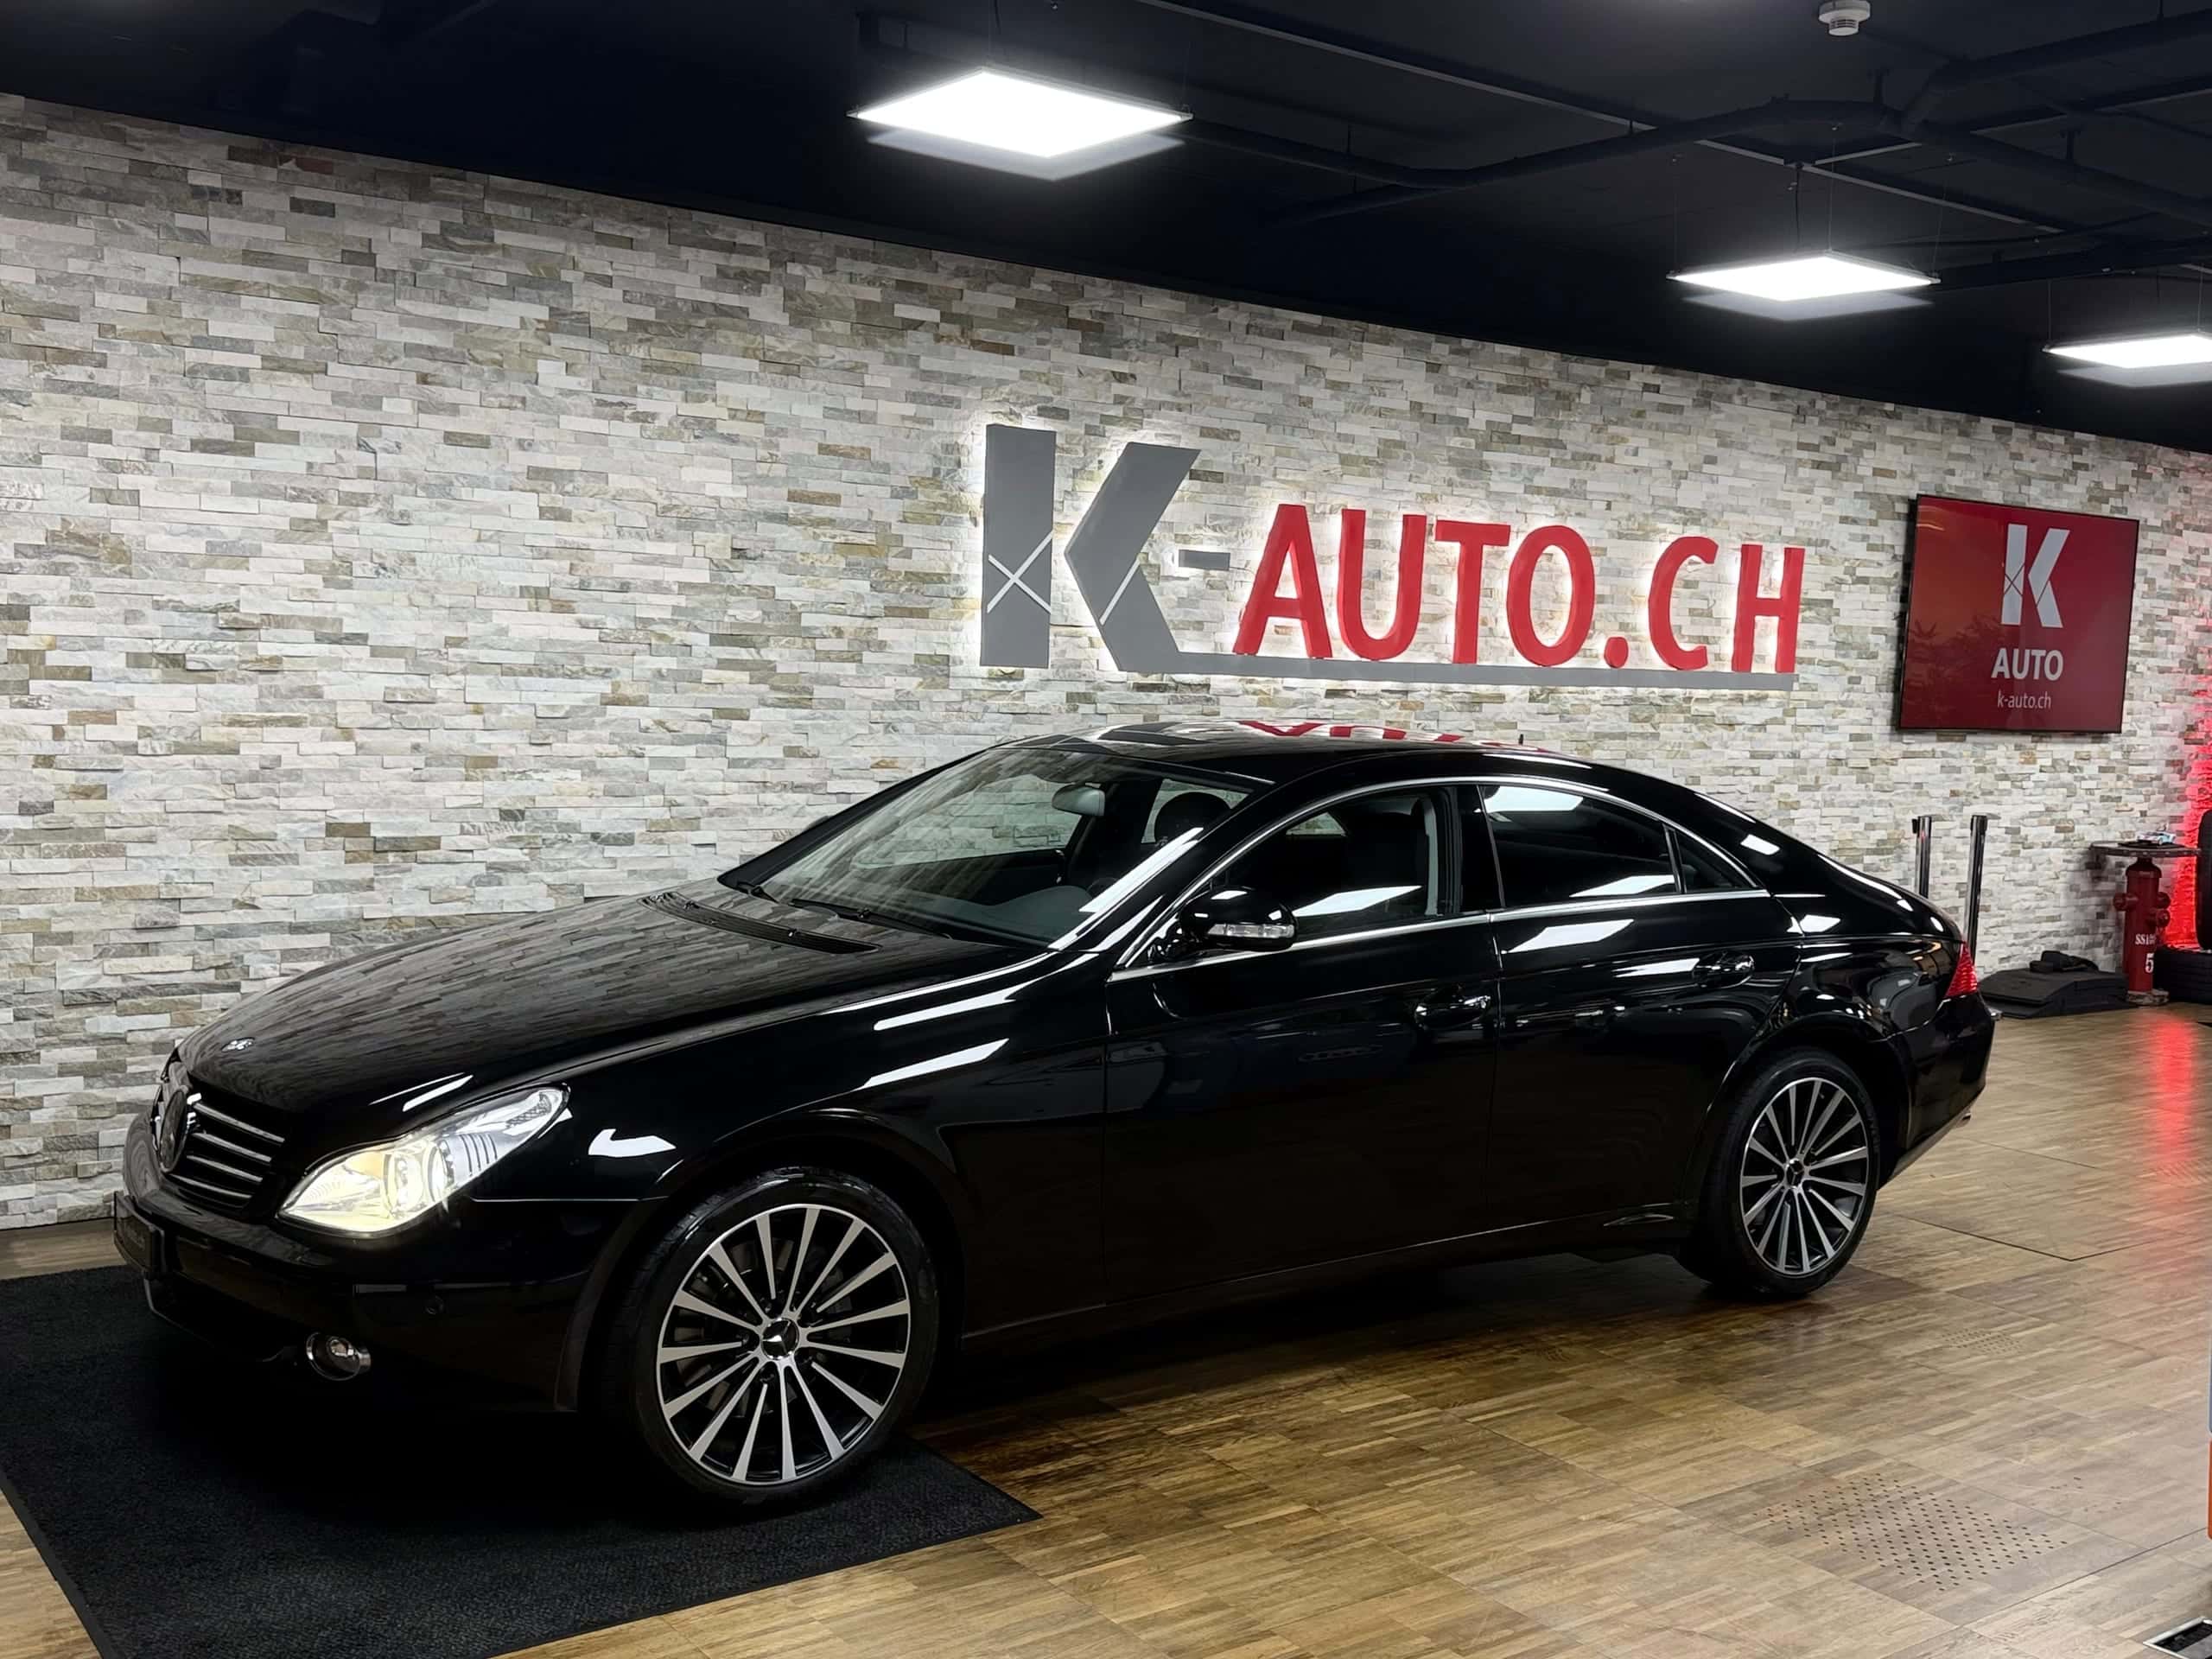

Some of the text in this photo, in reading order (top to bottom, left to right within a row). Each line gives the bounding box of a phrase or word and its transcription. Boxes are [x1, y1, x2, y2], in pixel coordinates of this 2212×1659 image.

[2001, 523, 2070, 628] K
[1991, 648, 2063, 681] AUTO
[1997, 690, 2051, 709] k-auto.ch
